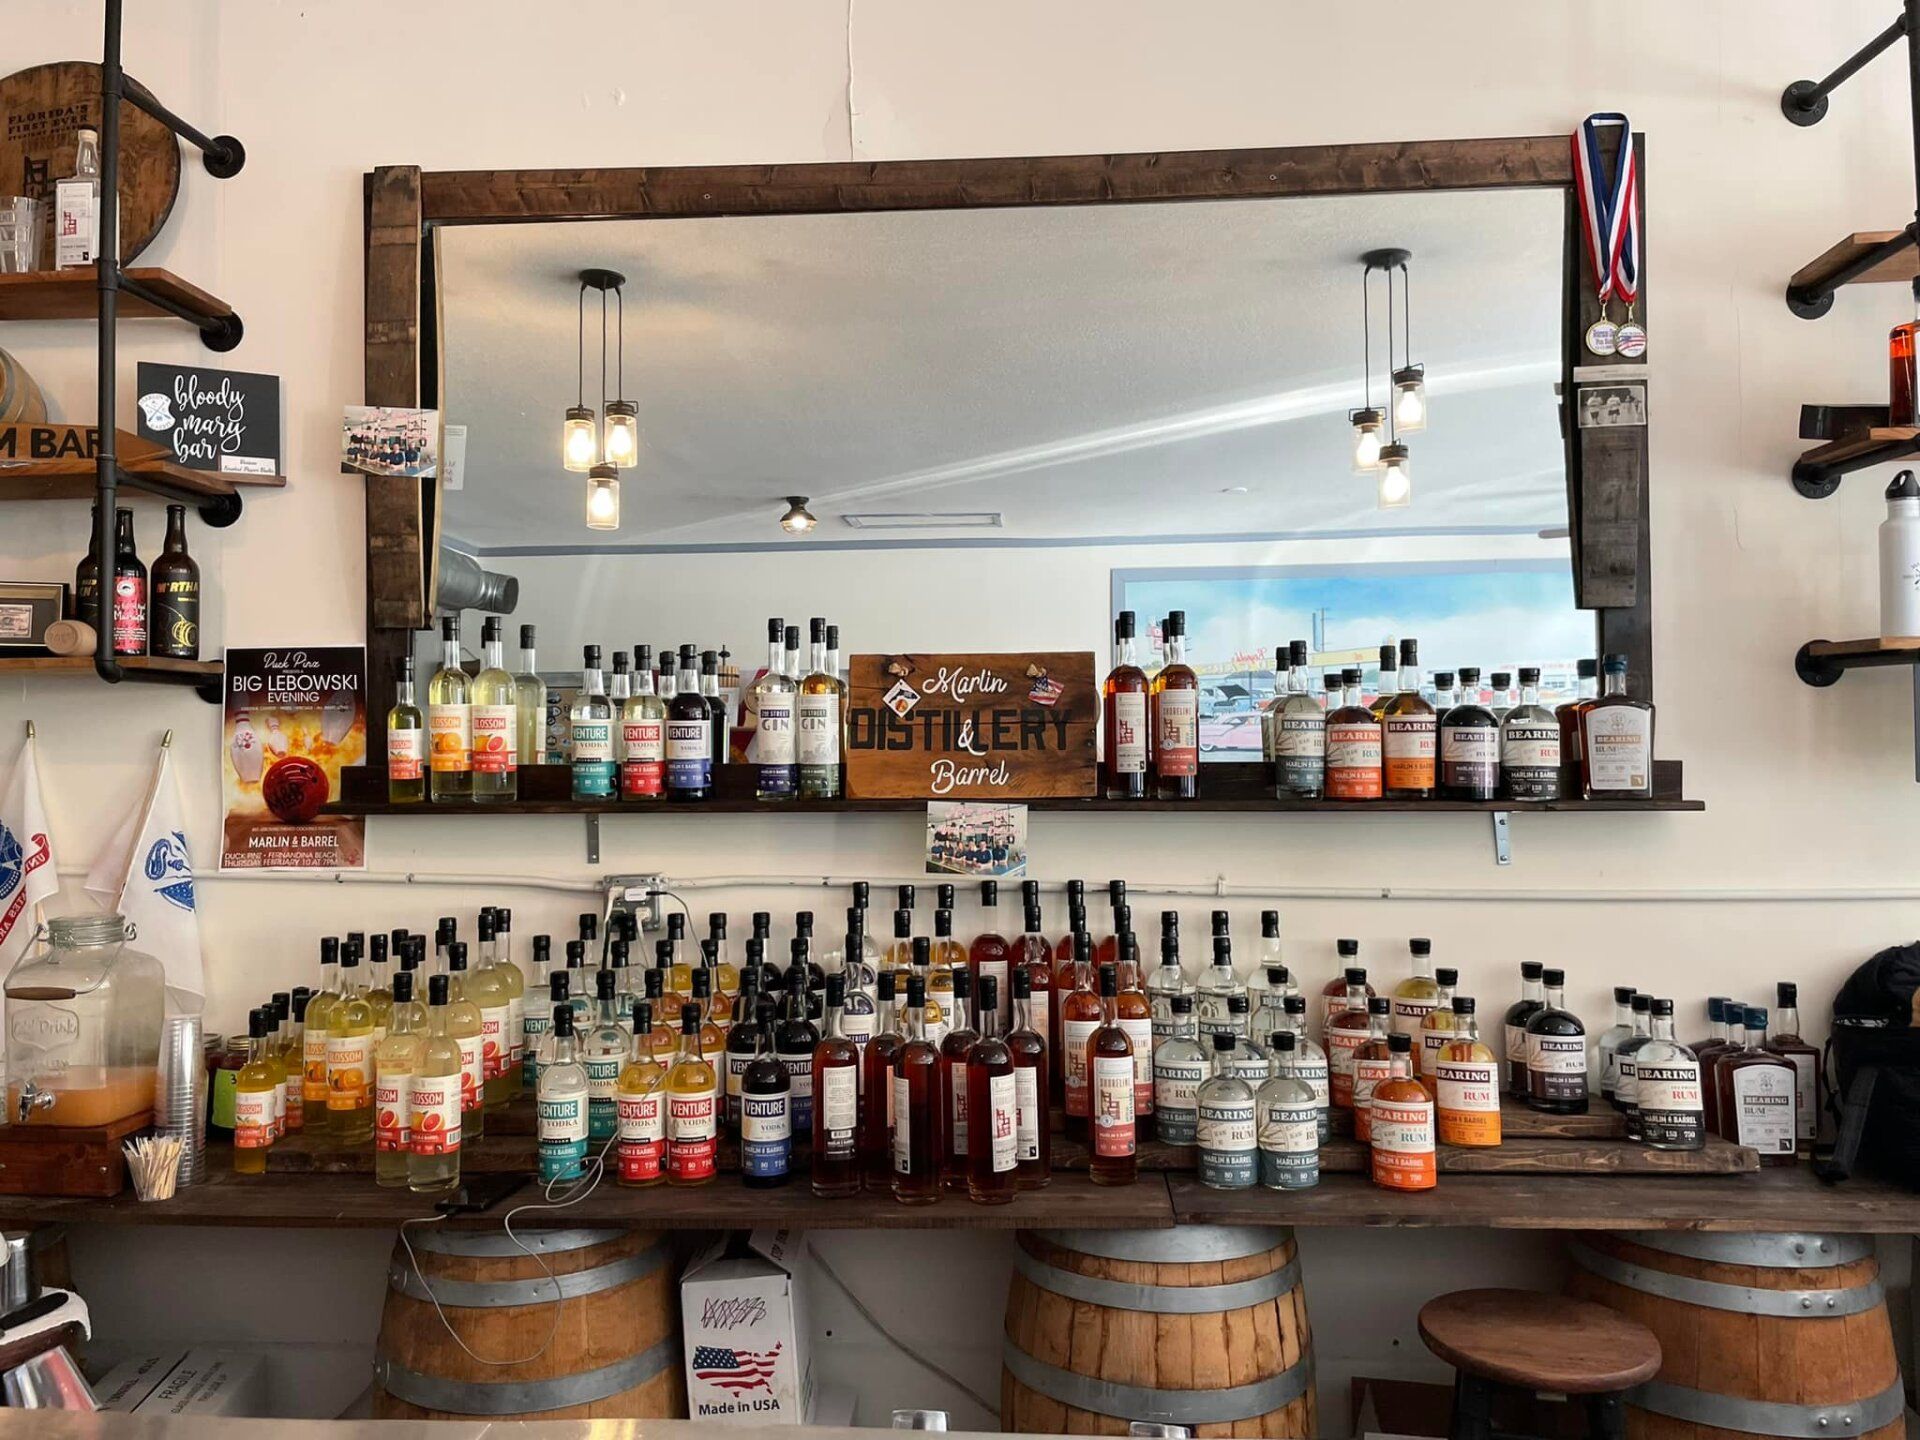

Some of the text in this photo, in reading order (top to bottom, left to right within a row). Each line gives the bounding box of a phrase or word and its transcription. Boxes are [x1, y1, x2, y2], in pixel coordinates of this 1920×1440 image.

[174, 375, 246, 422] bloody
[183, 415, 246, 453] mary
[173, 427, 217, 464] bar
[264, 651, 320, 668] Duck Pinz
[233, 674, 358, 692] BIG LEBOWSKI
[922, 666, 1008, 703] Marlin
[268, 691, 320, 703] EVENING
[762, 719, 789, 731] GIN
[802, 718, 826, 730] GIN
[850, 708, 1073, 751] DISTILLERY
[1284, 721, 1325, 730] BEARIN
[1389, 722, 1436, 731] BEARIN
[624, 727, 660, 739] VENTURE
[958, 719, 987, 756] &
[1313, 739, 1324, 747] RU
[930, 759, 1009, 794] Barrel
[249, 836, 339, 848] MARLIN & BARREL
[526, 1020, 548, 1032] VENT
[1543, 1042, 1582, 1050] BEARING
[1294, 1068, 1327, 1078] ARING
[1638, 1070, 1695, 1079] BEARING
[1464, 1091, 1489, 1100] RUM
[1673, 1091, 1697, 1100] RUM
[1745, 1096, 1787, 1104] BEARING
[673, 1101, 711, 1117] VENTURE
[746, 1101, 783, 1115] VENTURE
[1200, 1108, 1253, 1120] BEARING
[1272, 1109, 1318, 1121] BEARIN
[1674, 1116, 1697, 1124] BARREL
[547, 1119, 578, 1127] VODKA
[1231, 1131, 1254, 1140] RUM
[1306, 1131, 1316, 1140] RU
[1401, 1133, 1427, 1142] RUM
[1231, 1156, 1252, 1164] BARREL
[157, 1368, 197, 1399] FRAGILE
[699, 1399, 780, 1415] Made in USA
